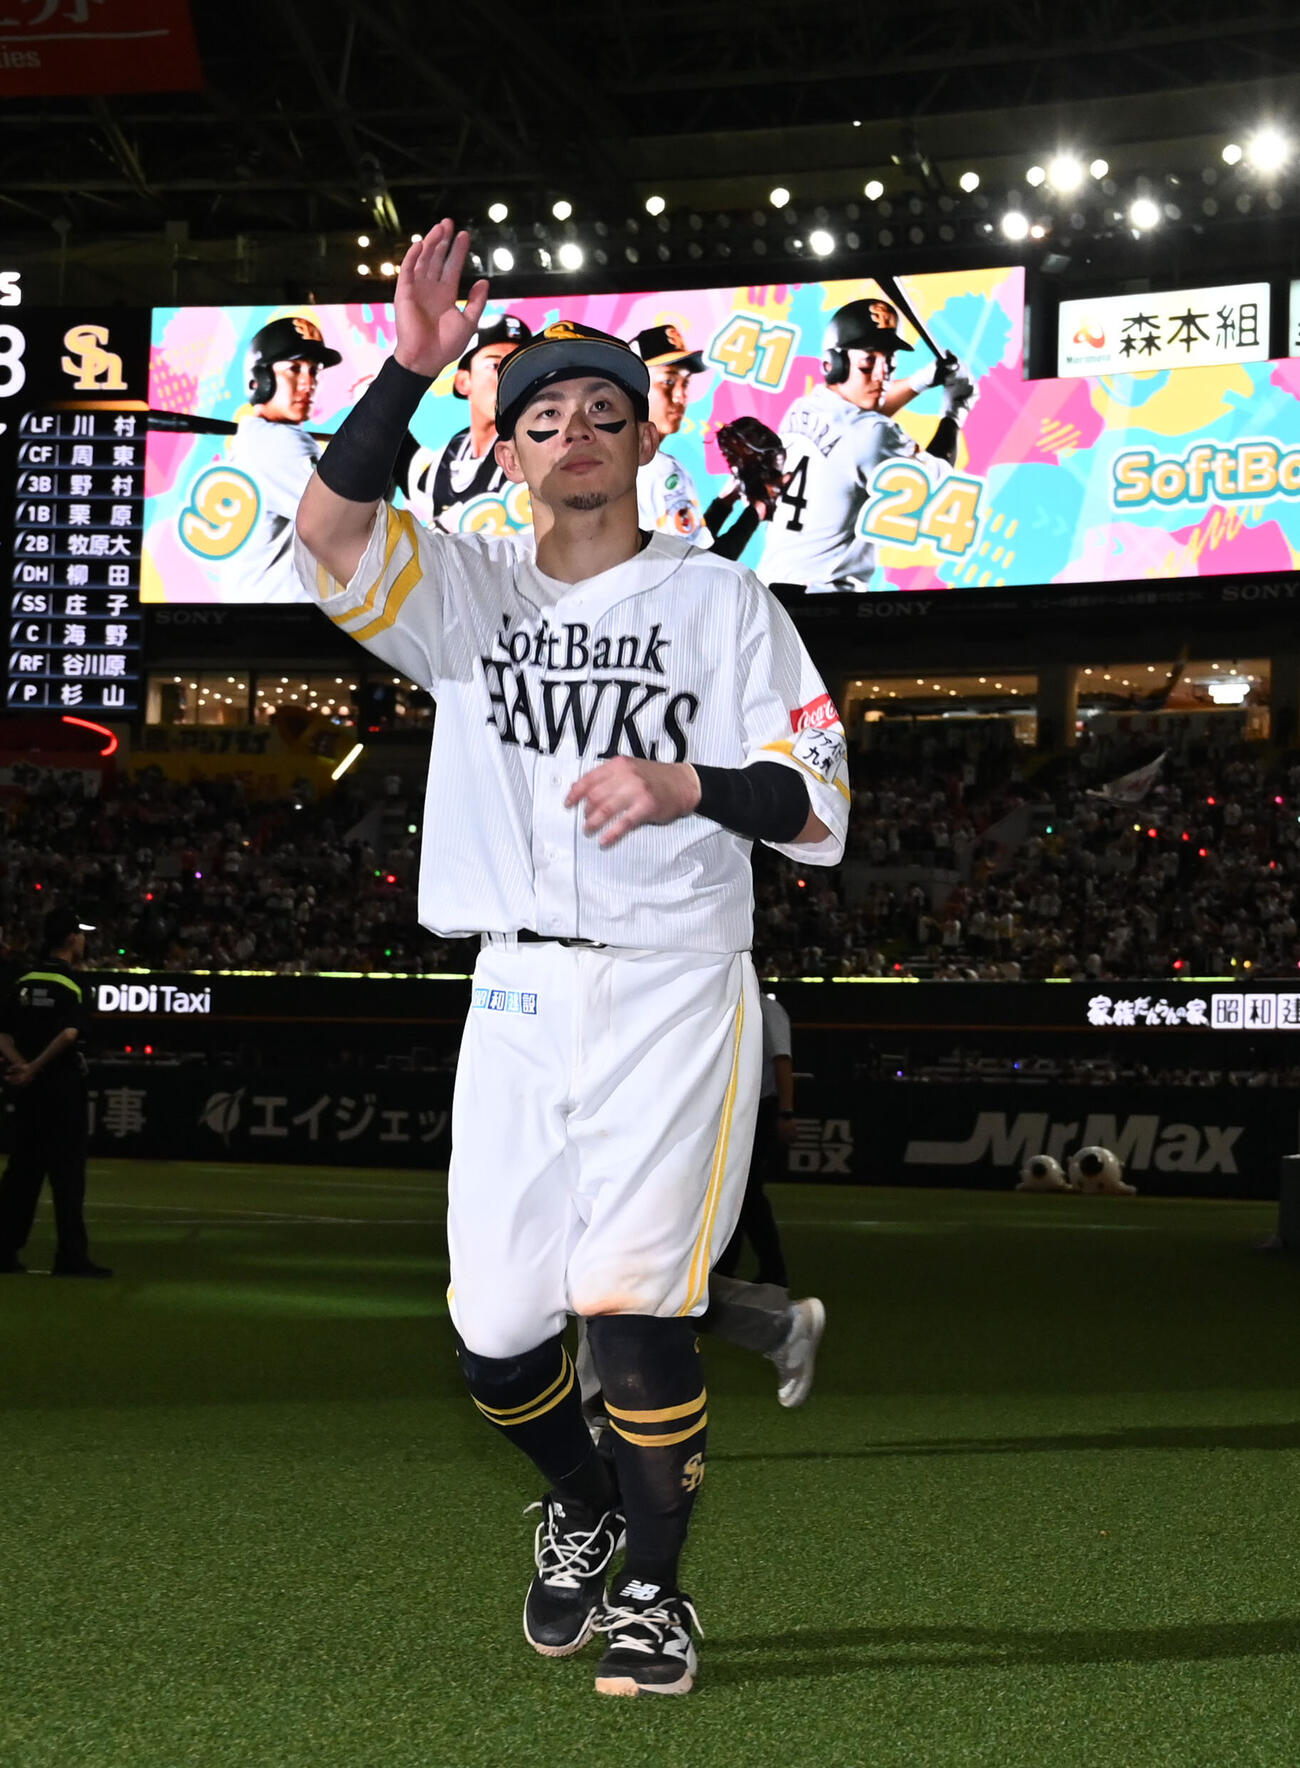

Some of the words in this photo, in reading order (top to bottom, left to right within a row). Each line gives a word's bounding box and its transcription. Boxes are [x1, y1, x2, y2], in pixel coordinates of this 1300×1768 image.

[0, 45, 41, 68] ies
[1119, 303, 1260, 358] 森本組
[710, 315, 799, 389] 41
[31, 416, 53, 433] LF
[28, 446, 52, 463] CF
[27, 475, 51, 493] 3B
[27, 506, 50, 523] 1B
[178, 465, 261, 561] 9
[861, 463, 983, 556] 24
[25, 535, 49, 553] 2B
[67, 534, 131, 556] 牧原大
[22, 565, 48, 583] DH
[1221, 583, 1300, 601] SONY
[22, 595, 47, 612] SS
[857, 601, 934, 618] SONY
[155, 610, 228, 625] SONY
[26, 625, 40, 642] C
[19, 654, 44, 672] RF
[62, 654, 126, 677] 谷川原
[23, 684, 37, 701] P
[481, 655, 700, 763] HAWKS
[97, 983, 158, 1013] DiDi
[159, 985, 211, 1014] Taxi
[88, 1085, 148, 1138] 事
[904, 1110, 1245, 1175] MrMax
